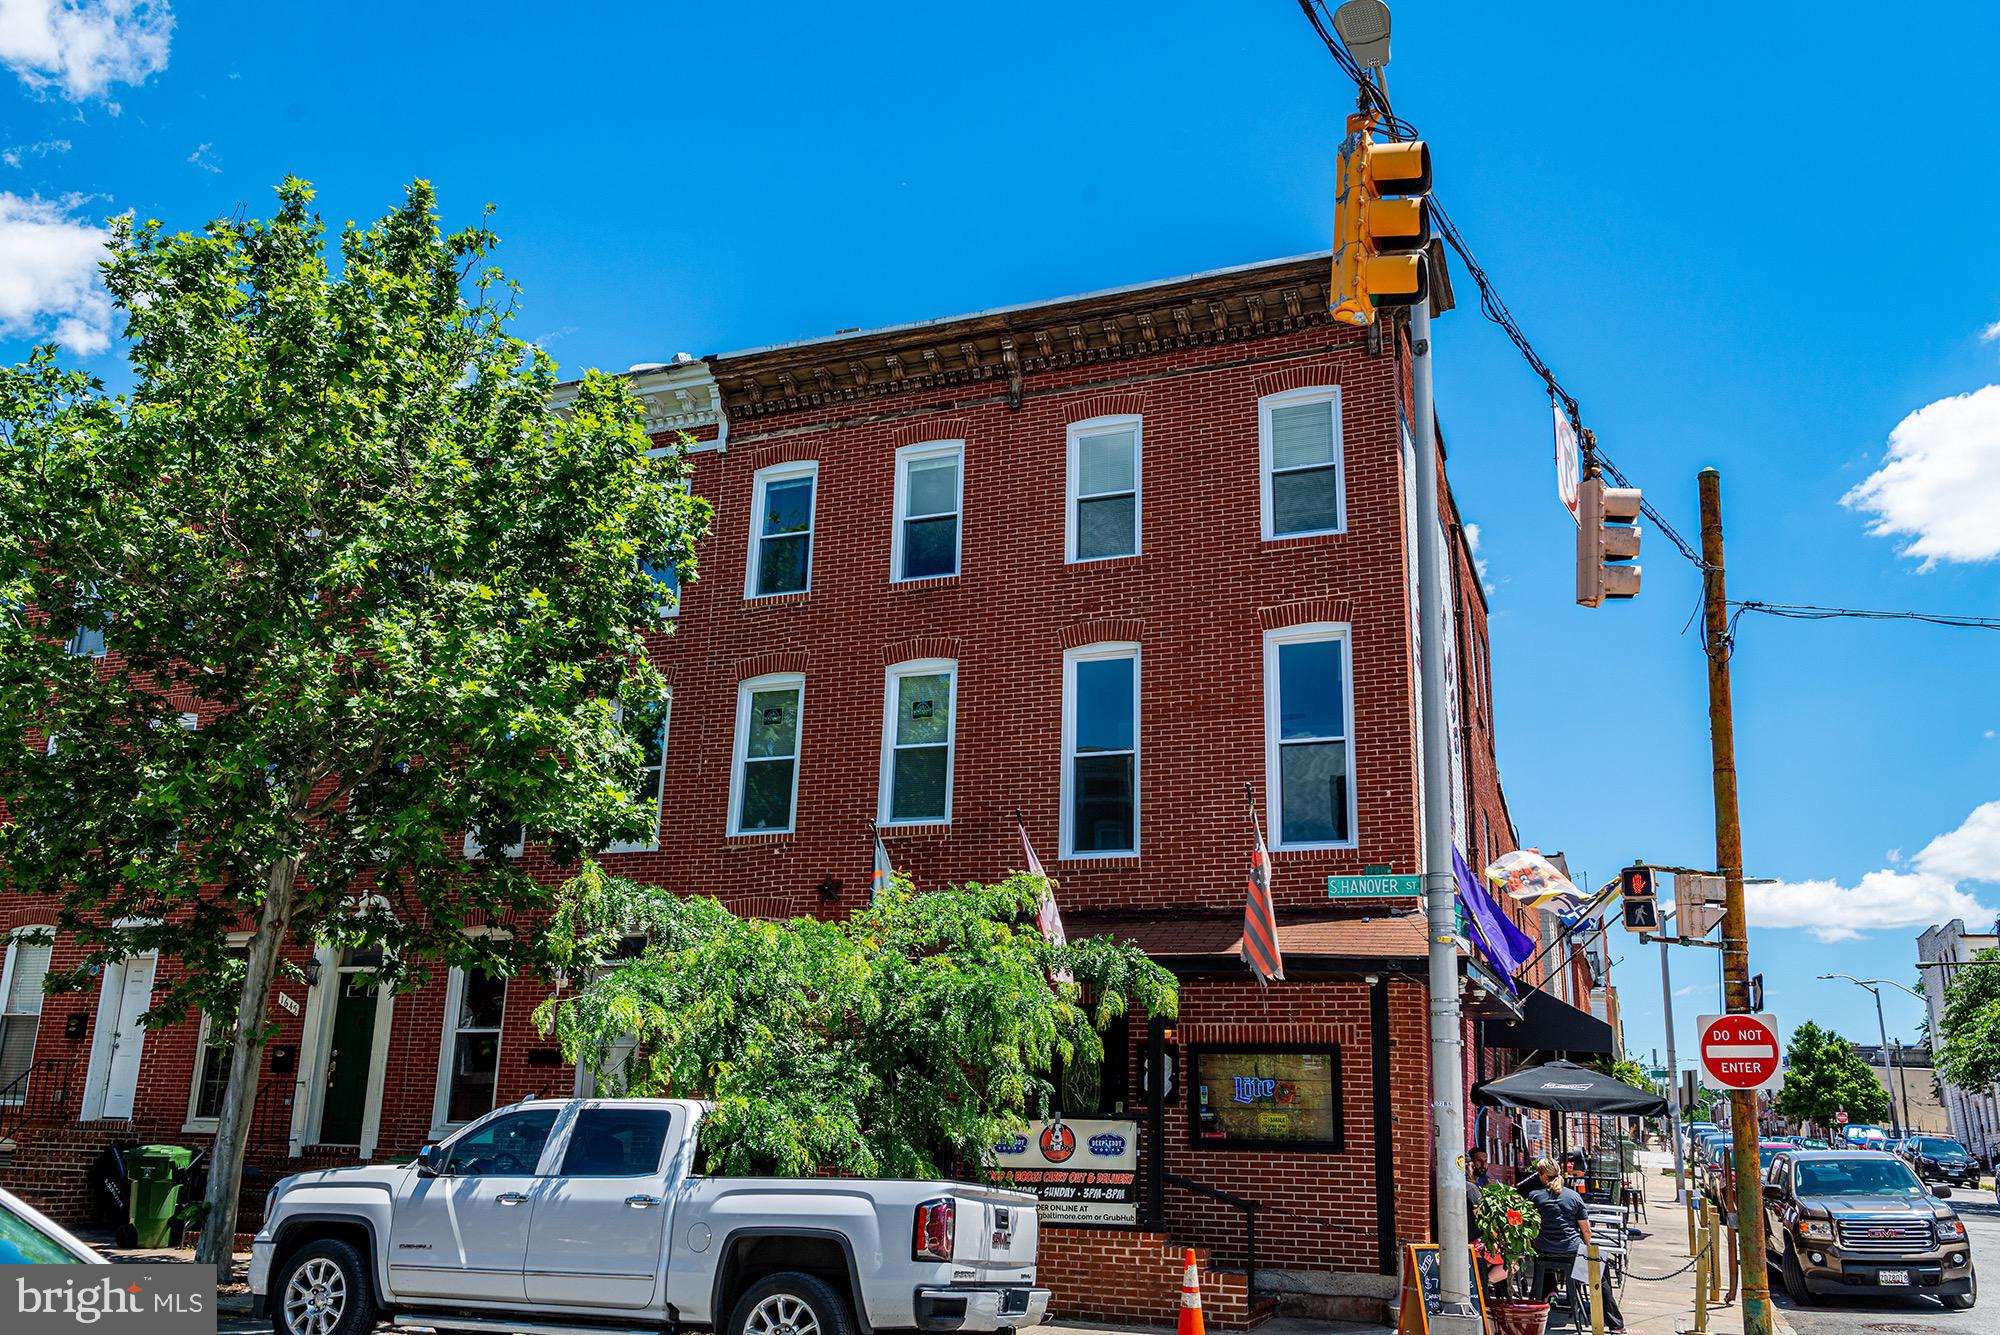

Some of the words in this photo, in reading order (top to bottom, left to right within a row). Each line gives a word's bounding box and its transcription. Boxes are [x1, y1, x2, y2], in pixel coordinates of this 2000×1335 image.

[1341, 879, 1399, 894] HANOVER
[1406, 881, 1419, 890] ST.
[1713, 1030, 1730, 1041] DO
[1738, 1030, 1762, 1040] NOT
[1721, 1062, 1761, 1073] ENTER
[1233, 1076, 1275, 1104] Lite
[1014, 1171, 1042, 1183] BOOZE
[1043, 1172, 1068, 1183] CARRY
[1068, 1172, 1087, 1184] OUT
[1087, 1173, 1096, 1184] &
[1096, 1173, 1134, 1185] DELIVERY
[1043, 1187, 1076, 1198] SUNDAY
[1083, 1188, 1125, 1199] 3PM-8PM
[1103, 1214, 1135, 1222] GrubHub
[1868, 1229, 1906, 1238] GMC
